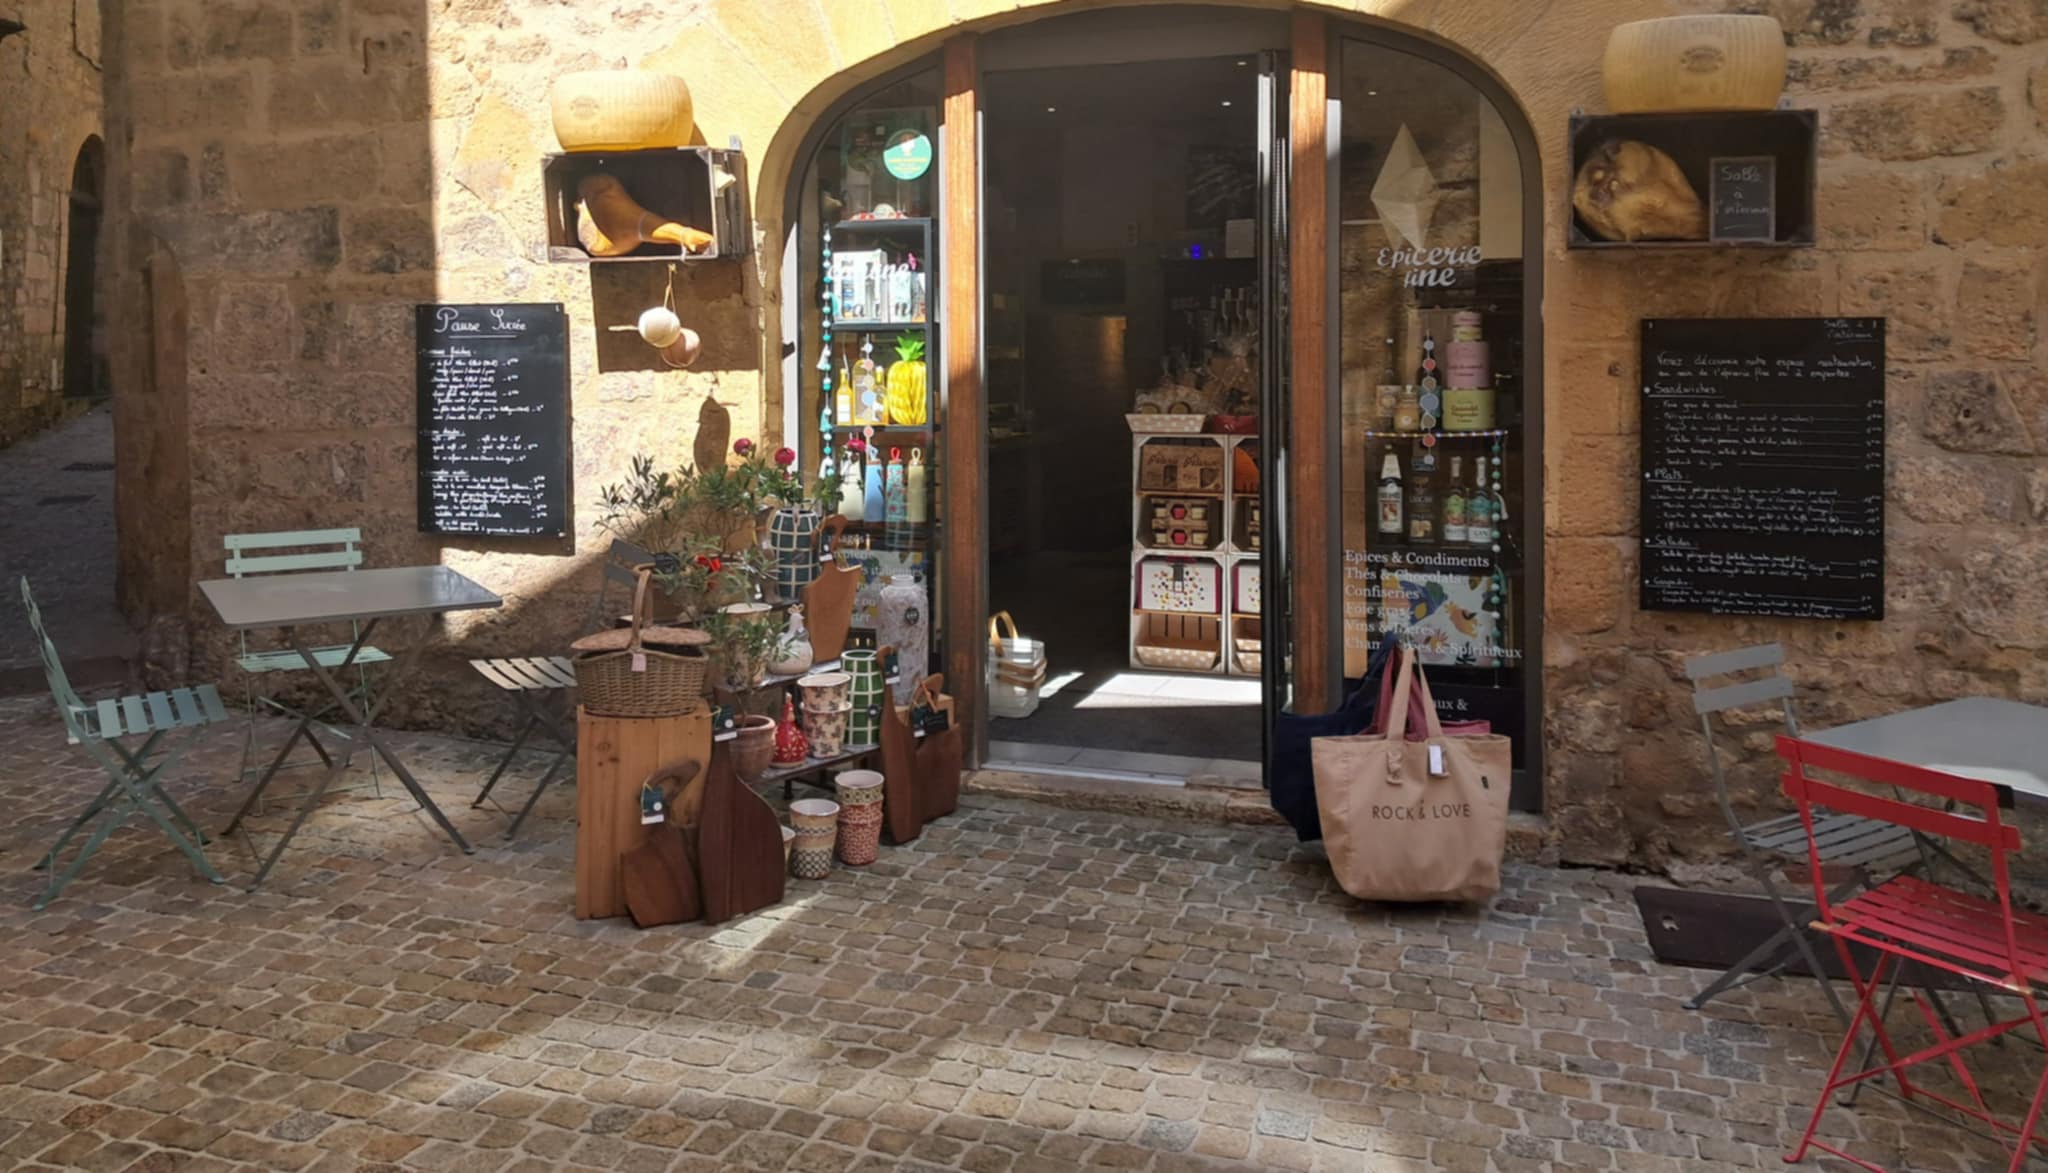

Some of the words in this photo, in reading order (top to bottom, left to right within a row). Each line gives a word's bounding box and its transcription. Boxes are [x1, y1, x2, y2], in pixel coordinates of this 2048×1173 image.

[1377, 245, 1482, 269] Epicerie
[1403, 266, 1457, 289] fine
[434, 306, 481, 333] Pause
[1345, 550, 1389, 564] Epices
[1391, 552, 1402, 563] &
[1406, 552, 1490, 568] Condiments
[1345, 585, 1420, 600] Confiseries
[1372, 805, 1416, 821] ROCK
[1432, 803, 1472, 820] LOVE
